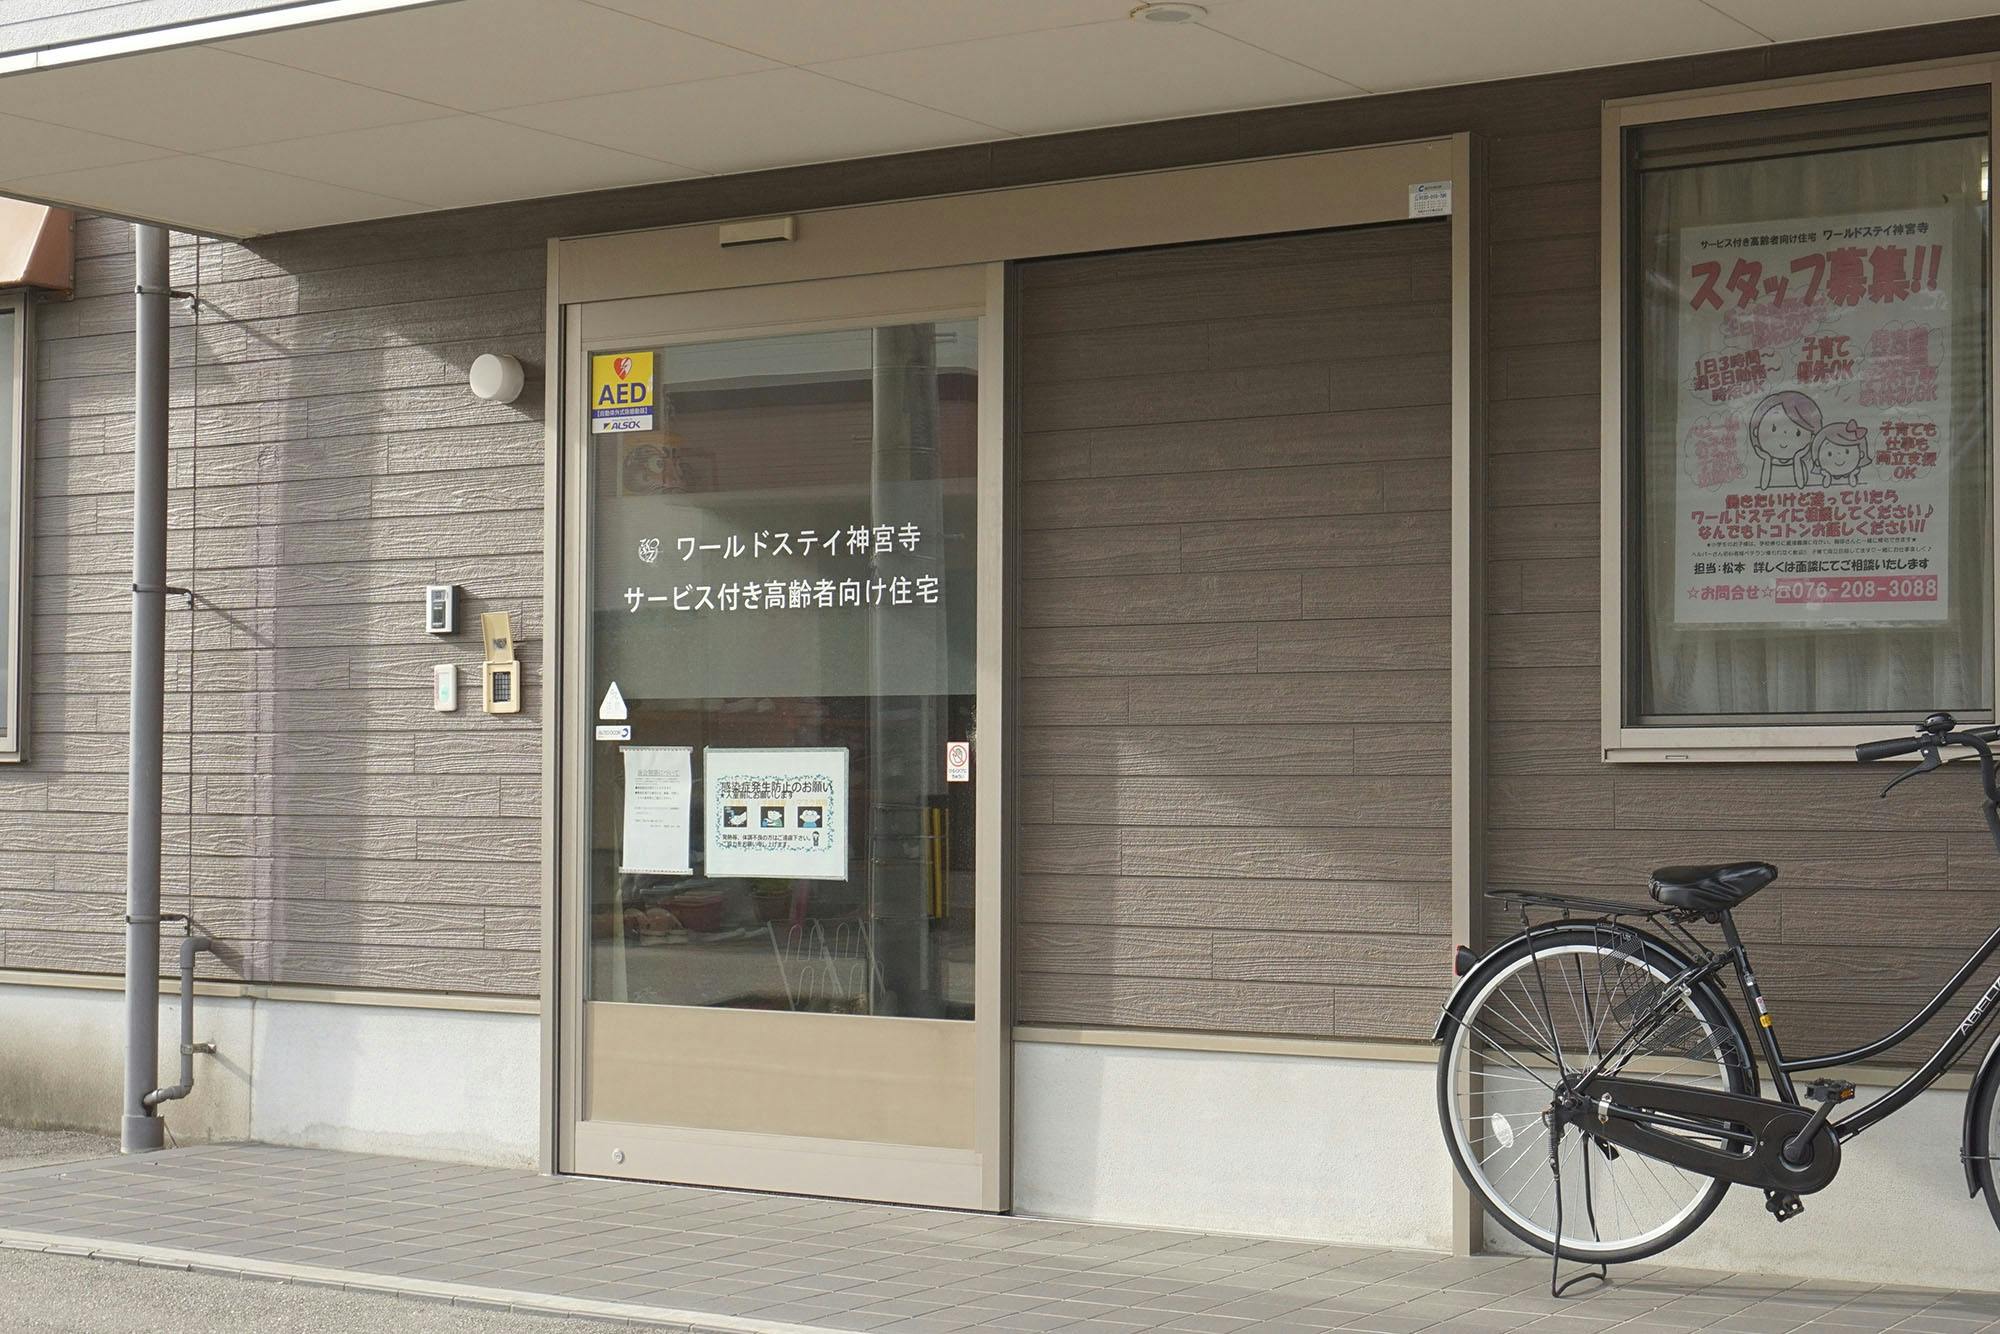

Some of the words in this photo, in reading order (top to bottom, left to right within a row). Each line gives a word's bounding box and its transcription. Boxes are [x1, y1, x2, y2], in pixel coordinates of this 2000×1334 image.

[1700, 232, 1816, 249] サービス付き高齢者向け住宅
[1823, 222, 1929, 241] ワールドステイ神宮寺
[1802, 336, 1850, 361] 子育て
[598, 382, 647, 406] AED
[611, 420, 641, 430] ALSOK
[1880, 420, 1937, 438] 子育ても
[1885, 437, 1930, 452] 仕事も
[1893, 466, 1917, 480] OK
[1726, 489, 1899, 509] 働きたいけど迷っていたら
[676, 521, 921, 562] ワールドステイ神宮寺
[1753, 558, 1930, 574] 詳しくは面談にてご相談いたします
[623, 574, 940, 613] サービス付き高齢者向け住宅
[1791, 577, 1938, 600] 076-208-3088
[720, 781, 833, 793] 感染症発生防止のお願い
